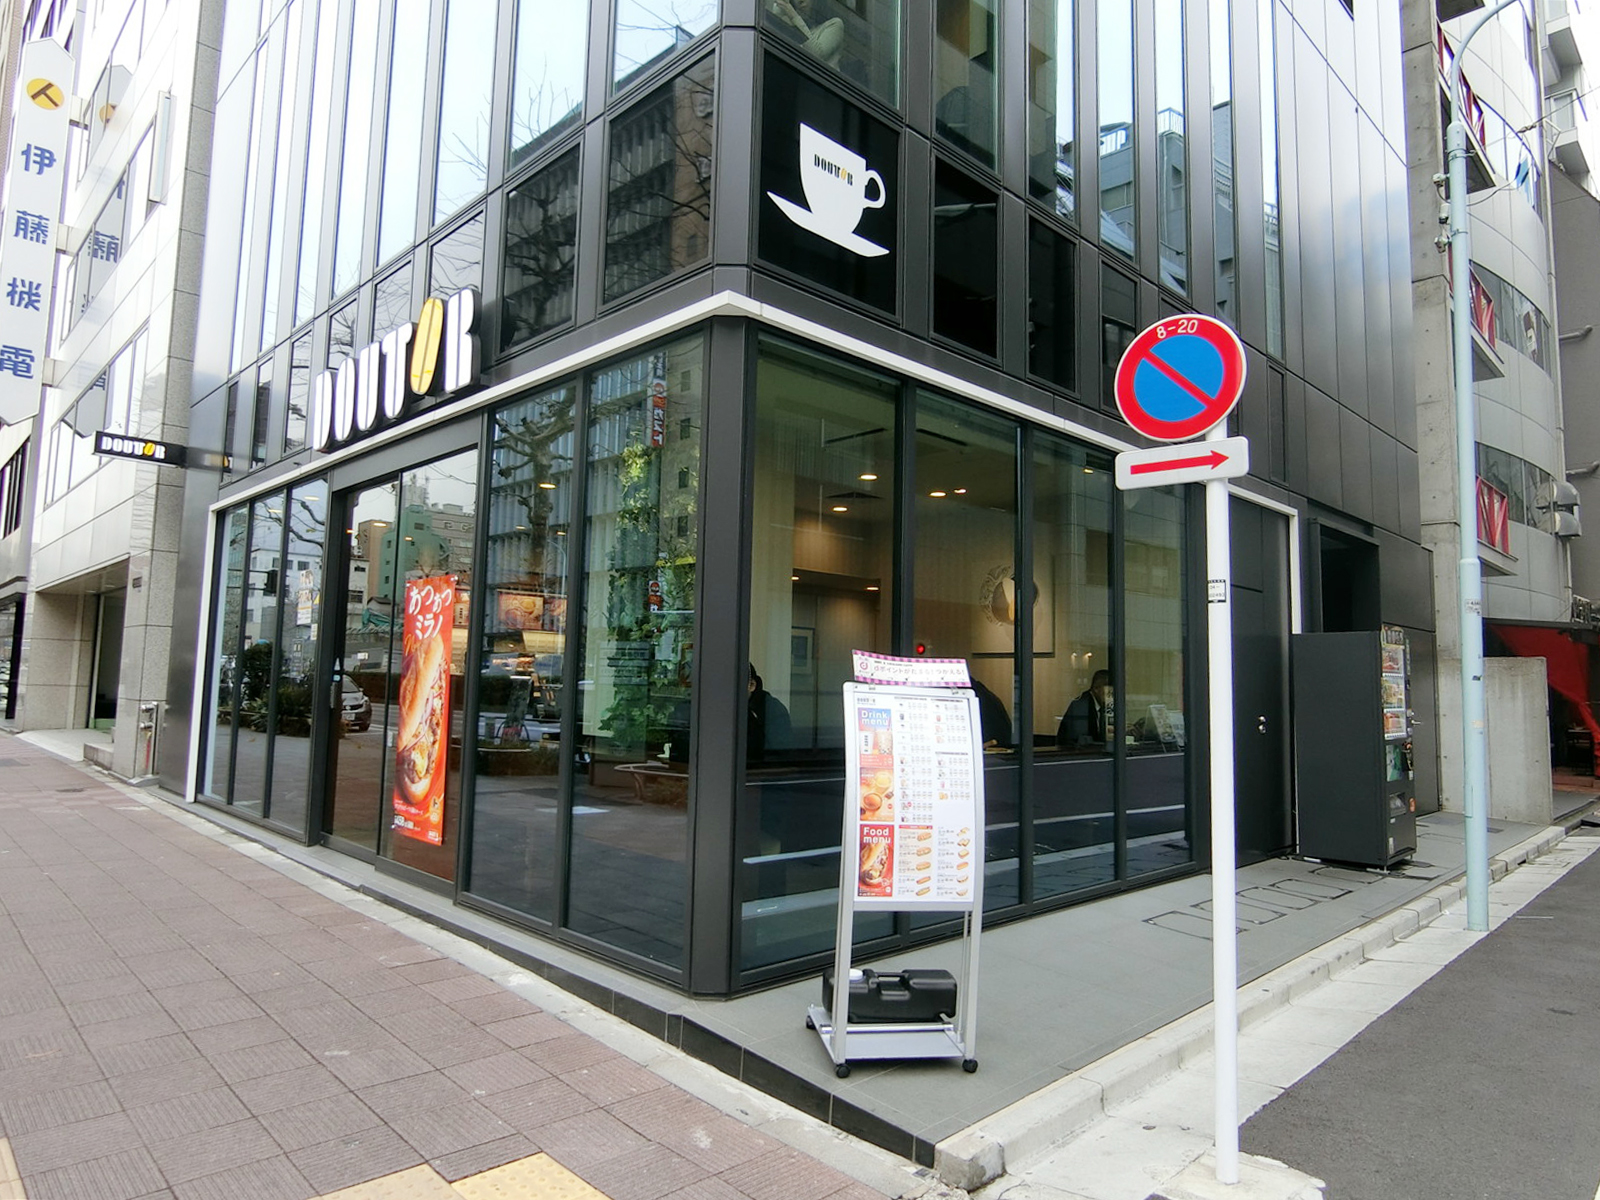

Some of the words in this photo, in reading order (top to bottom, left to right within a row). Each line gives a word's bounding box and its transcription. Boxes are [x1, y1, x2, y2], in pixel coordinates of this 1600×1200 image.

[813, 153, 854, 186] DOUTOR
[0, 142, 57, 380] 伊藤機電
[1156, 319, 1198, 339] 8-20
[312, 287, 475, 451] DOUTOR
[101, 436, 166, 460] DOUTOR
[410, 586, 452, 614] あつあつ
[415, 613, 443, 640] ミラノ
[861, 710, 888, 719] Drink
[861, 718, 888, 726] menu
[863, 827, 889, 836] Food
[863, 836, 891, 844] menu
